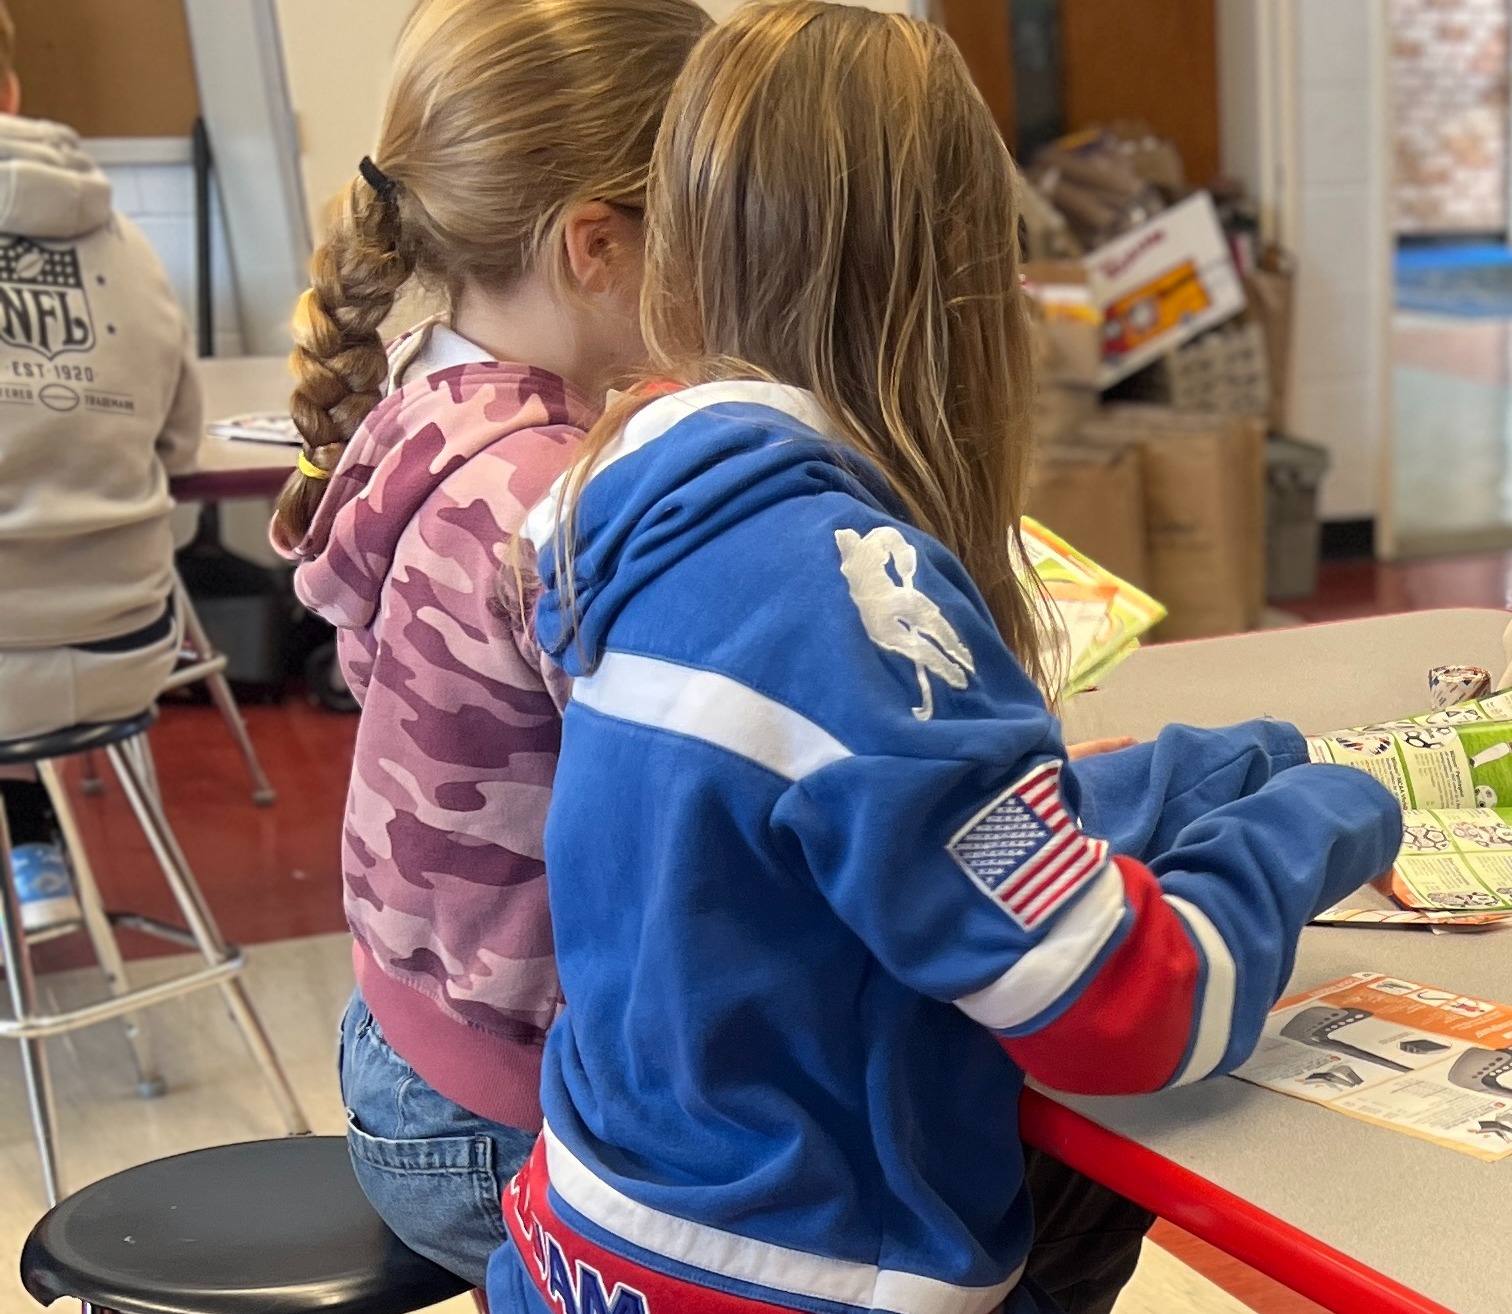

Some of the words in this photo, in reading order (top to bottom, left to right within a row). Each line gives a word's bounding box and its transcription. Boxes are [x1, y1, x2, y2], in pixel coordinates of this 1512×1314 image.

[0, 286, 89, 353] NFL
[12, 361, 44, 378] EST
[54, 365, 94, 382] 1920
[85, 395, 134, 409] TRADEMARK
